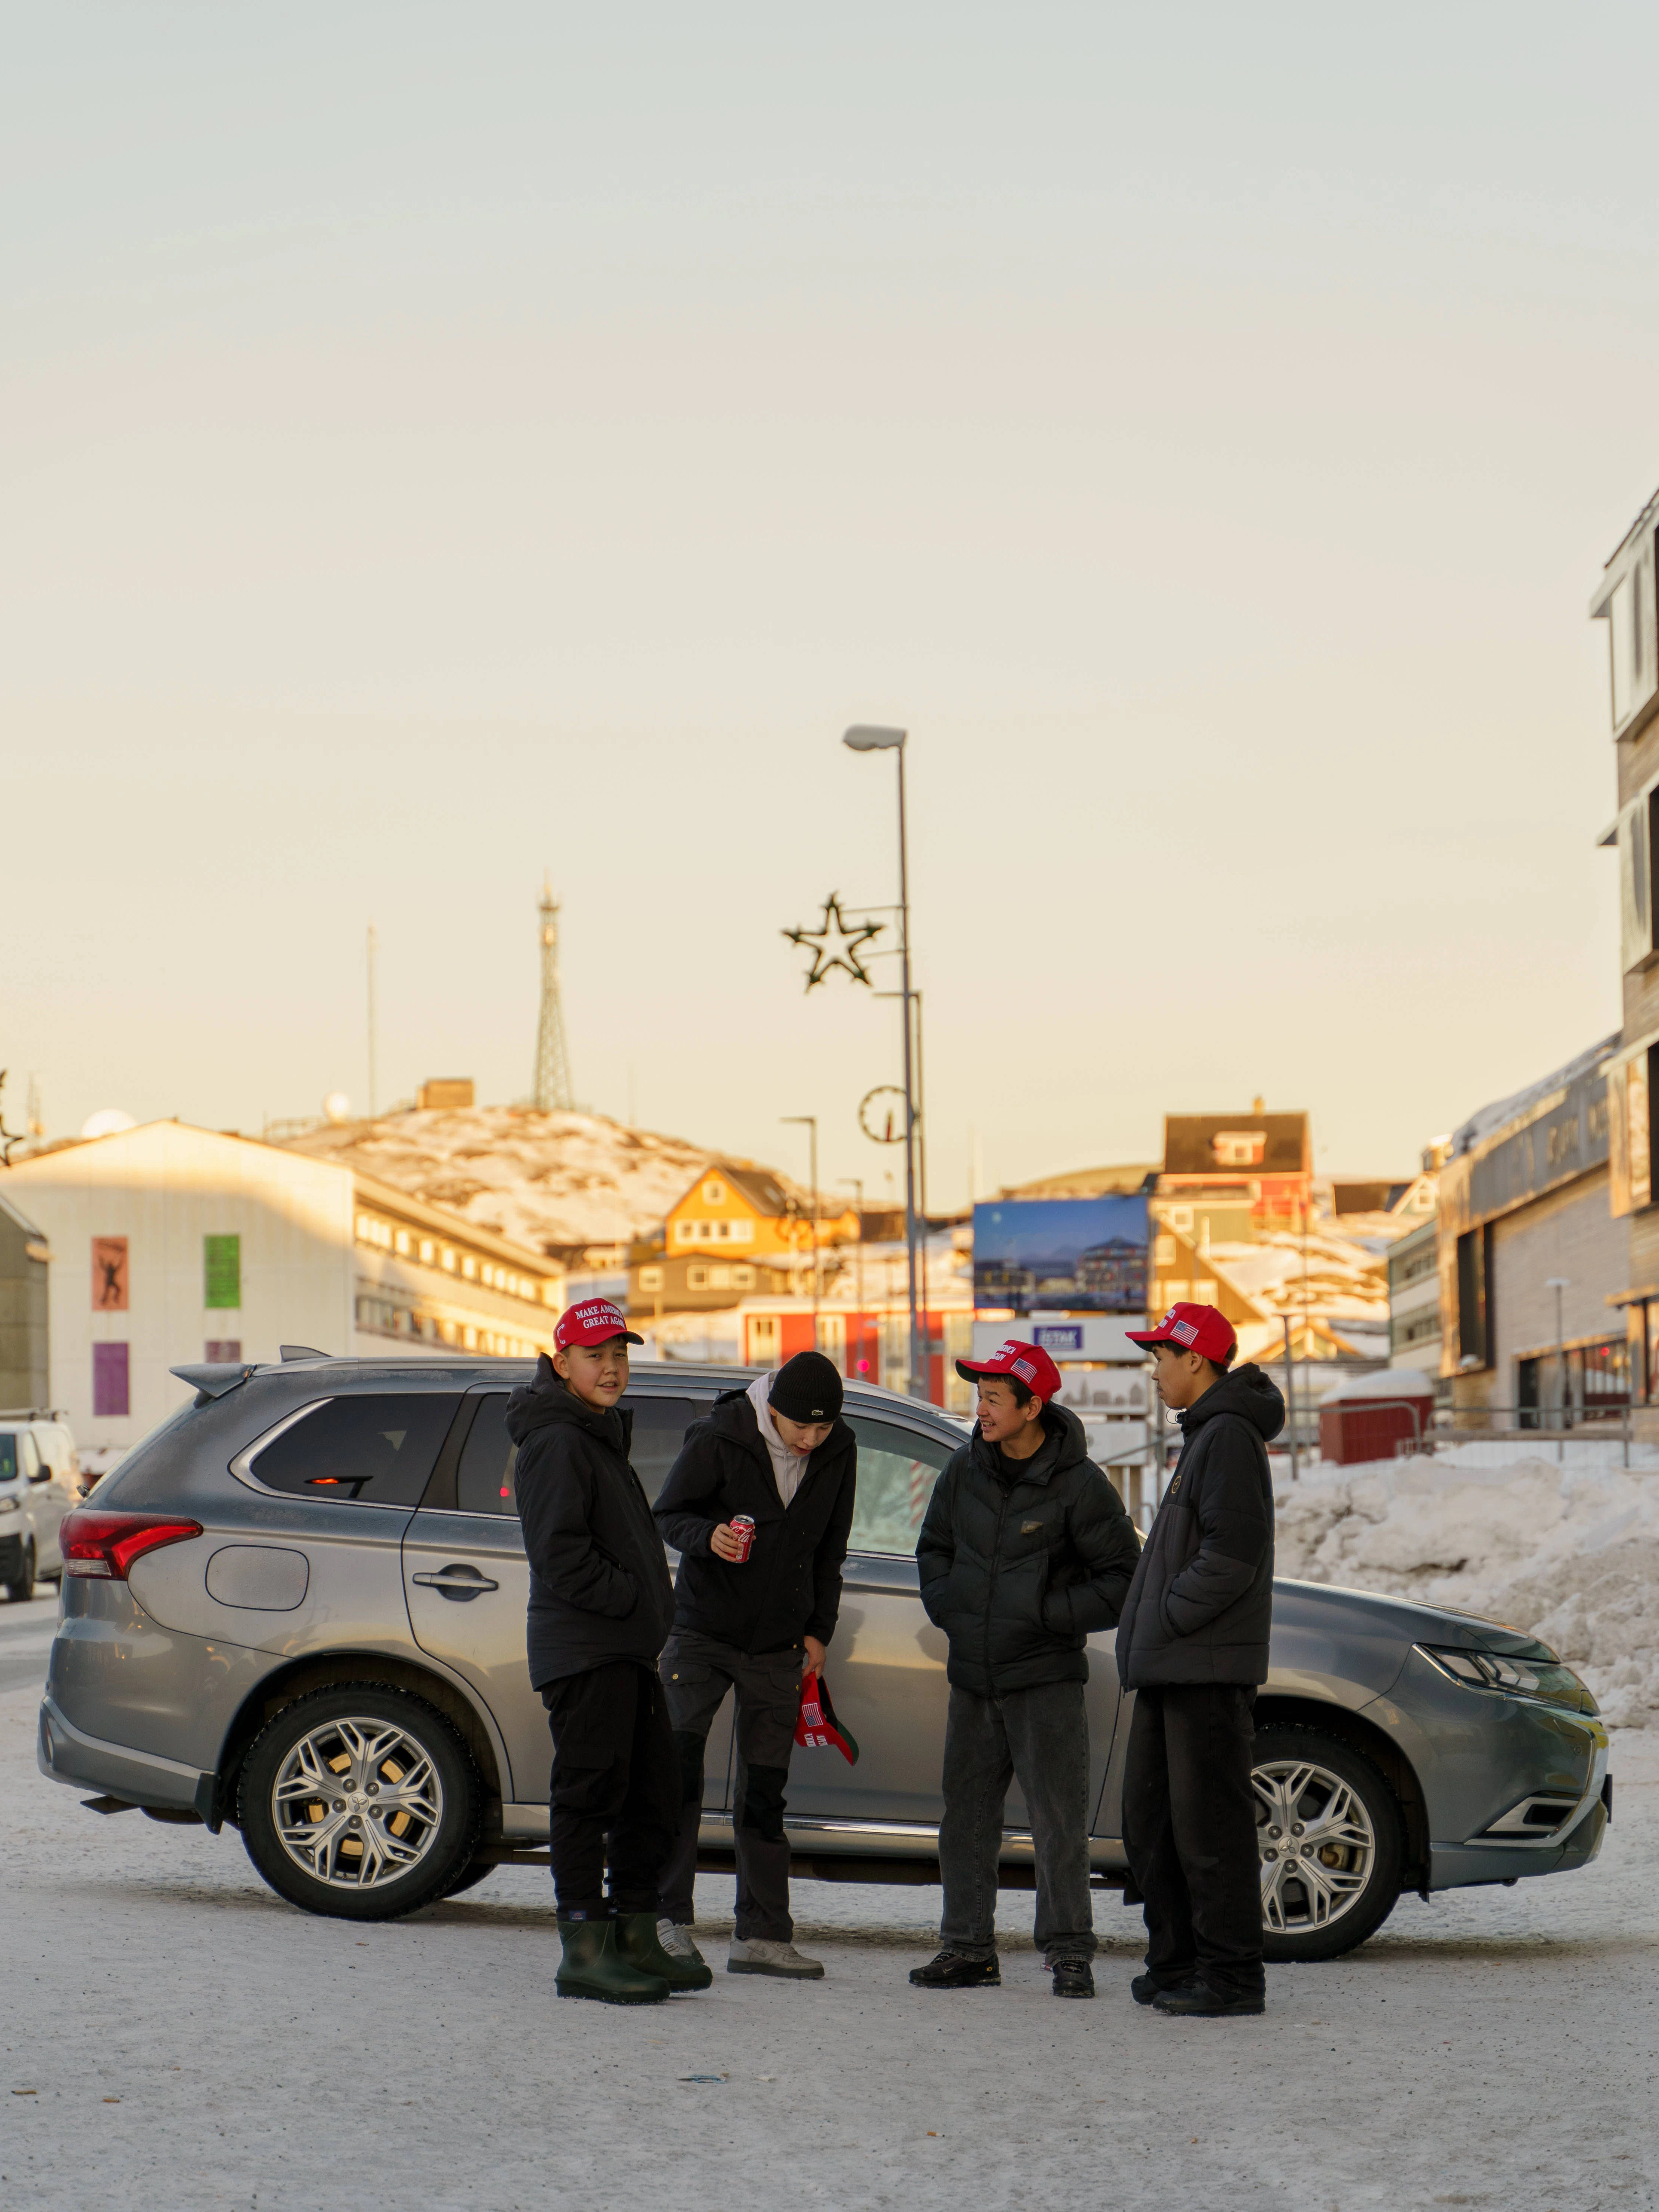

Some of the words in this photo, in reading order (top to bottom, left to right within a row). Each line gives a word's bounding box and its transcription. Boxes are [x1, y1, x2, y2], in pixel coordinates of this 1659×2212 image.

[575, 1306, 599, 1320] MAKE
[583, 1316, 609, 1328] GREAT
[991, 1353, 1006, 1361] GAIN
[804, 1733, 817, 1747] ERICA
